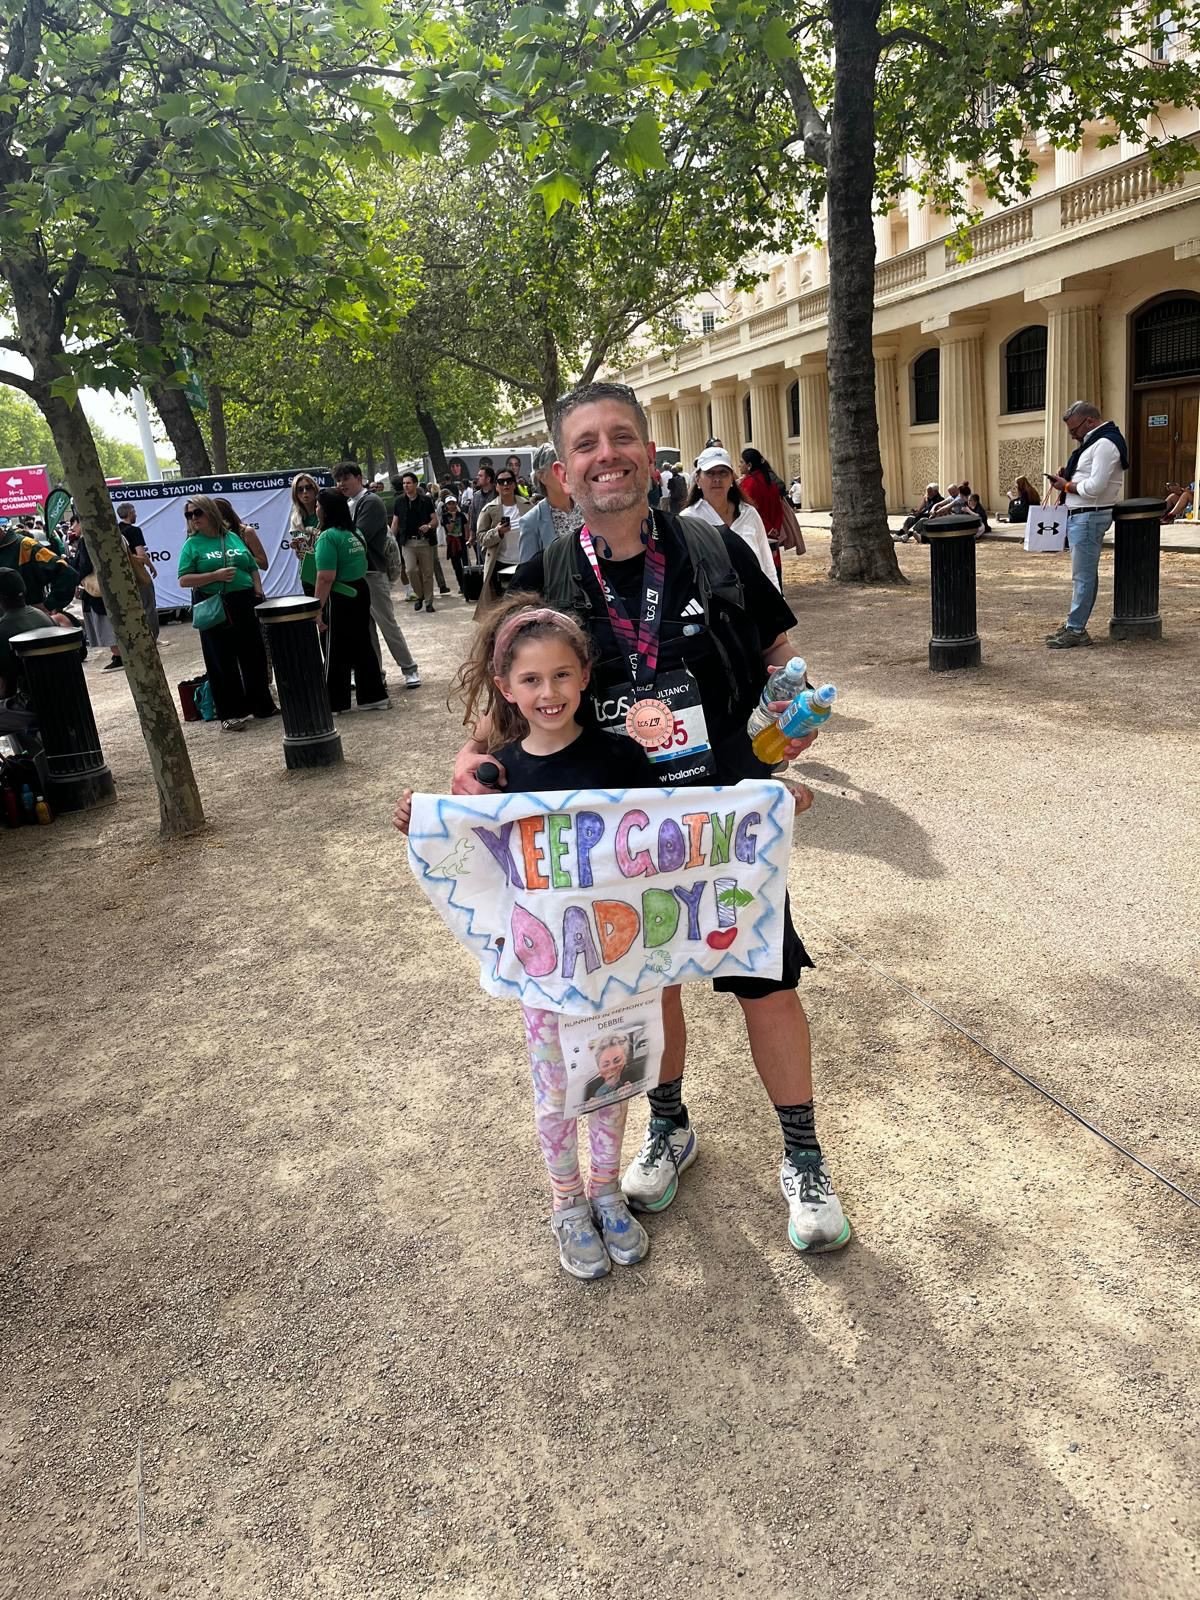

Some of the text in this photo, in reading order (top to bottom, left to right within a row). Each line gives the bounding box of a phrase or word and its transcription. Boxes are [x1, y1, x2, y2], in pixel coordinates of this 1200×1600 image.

[109, 483, 203, 500] ECYCLING STATION
[231, 478, 285, 491] RECYCLING
[2, 501, 37, 510] CHANGING
[205, 548, 243, 560] NSCC
[593, 695, 632, 722] tcs
[613, 808, 761, 879] GOING
[564, 1015, 601, 1029] RUNNING
[611, 1002, 644, 1015] MEMORY
[597, 1016, 625, 1030] DEBBIE
